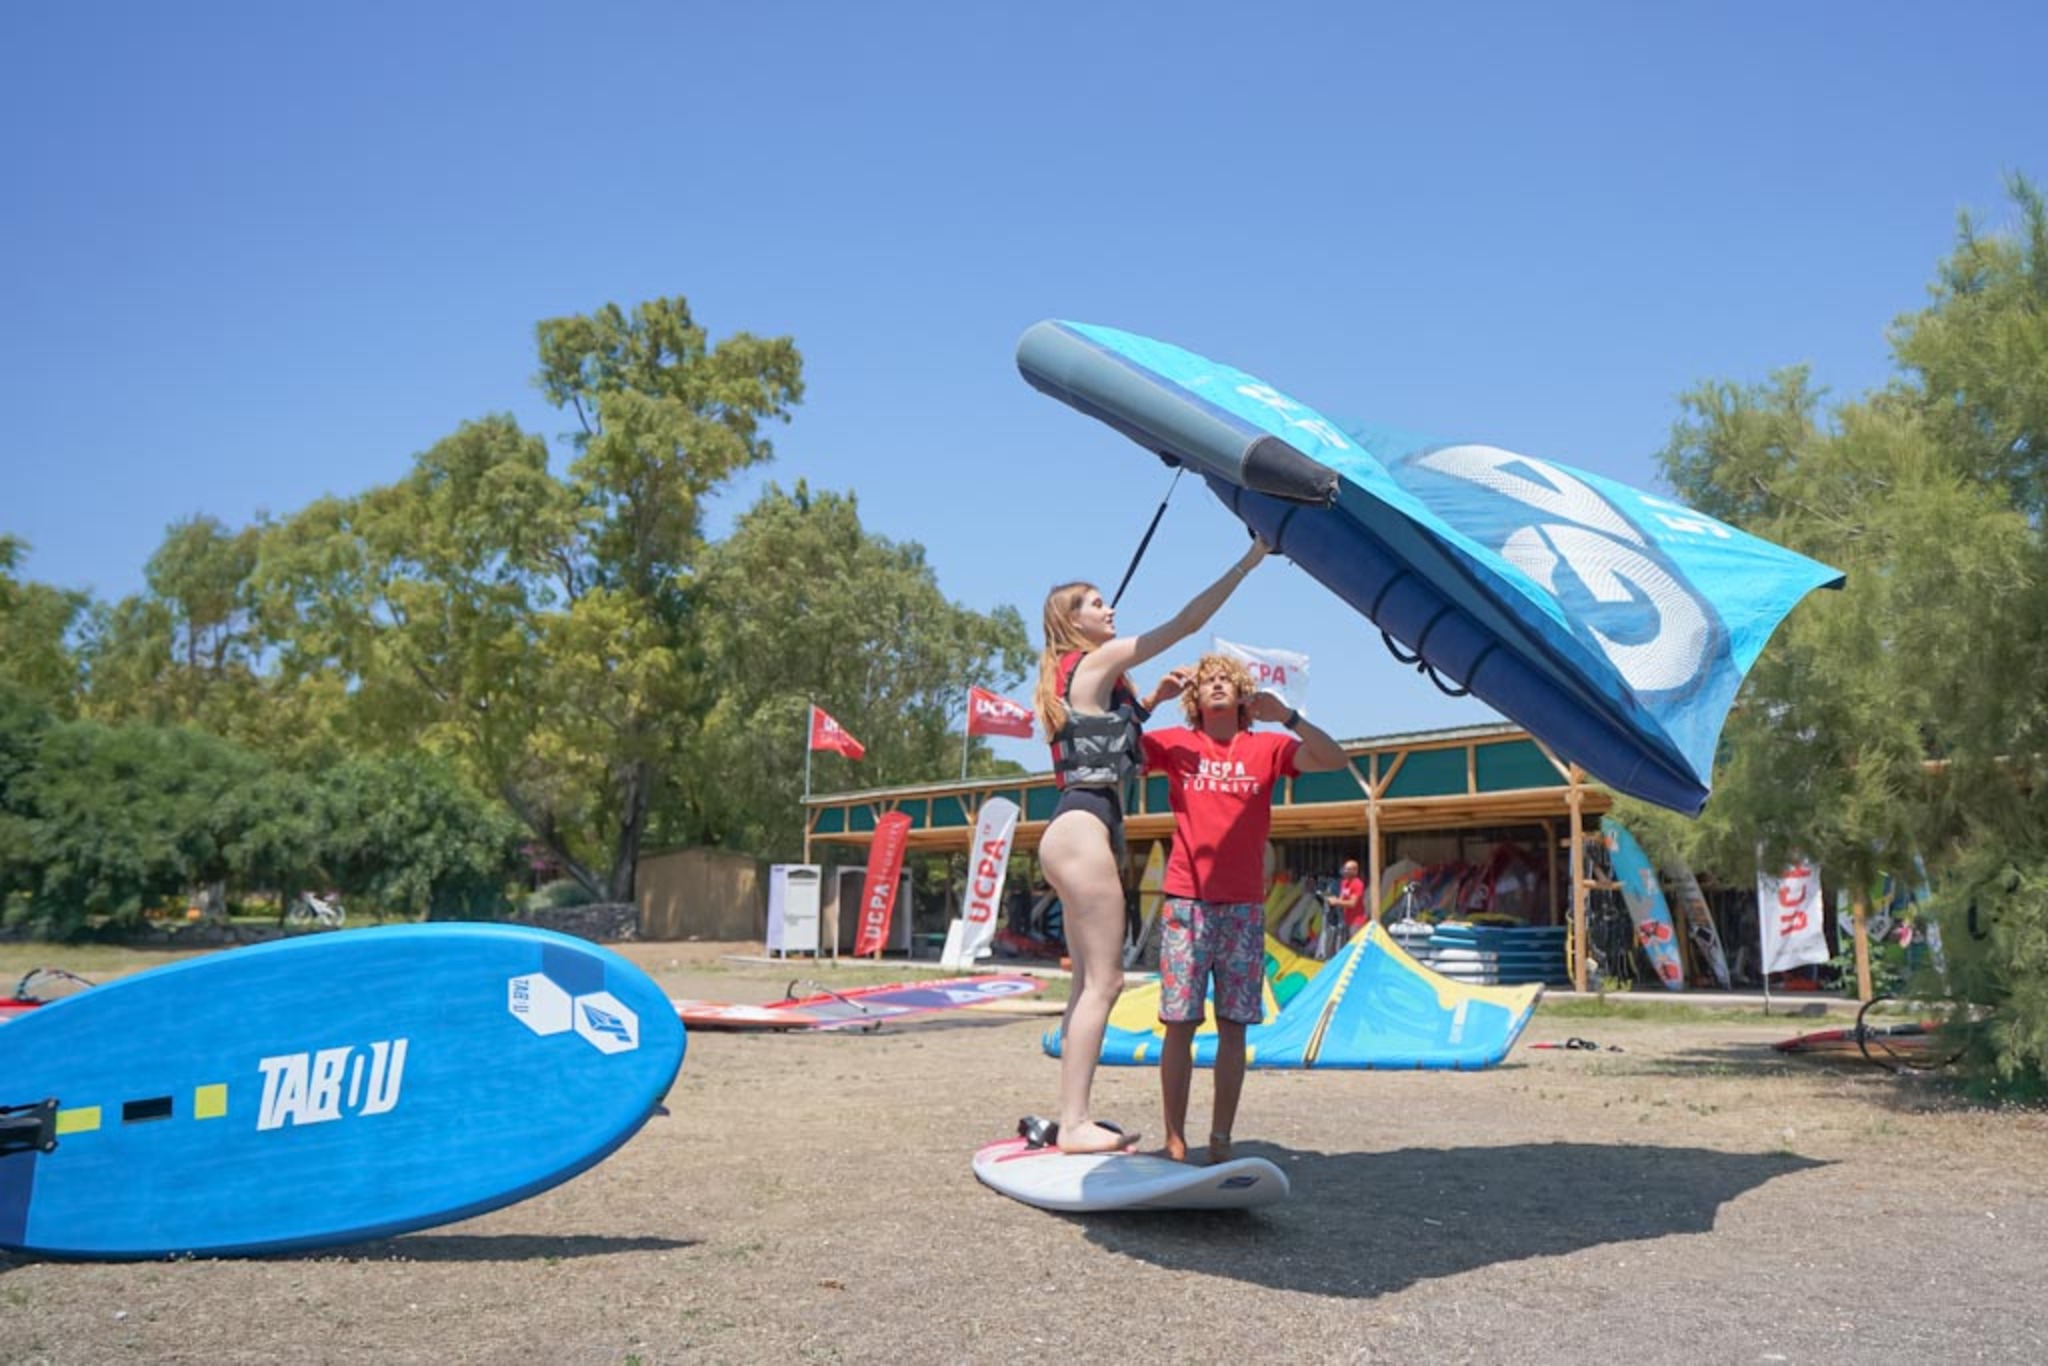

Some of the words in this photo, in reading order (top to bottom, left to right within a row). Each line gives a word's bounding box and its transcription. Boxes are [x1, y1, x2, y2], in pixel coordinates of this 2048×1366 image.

[1247, 661, 1286, 685] CPA
[1199, 759, 1246, 777] UCPA
[968, 837, 1006, 924] UCPA
[865, 883, 890, 939] UCPA
[256, 1038, 409, 1131] TABOU
